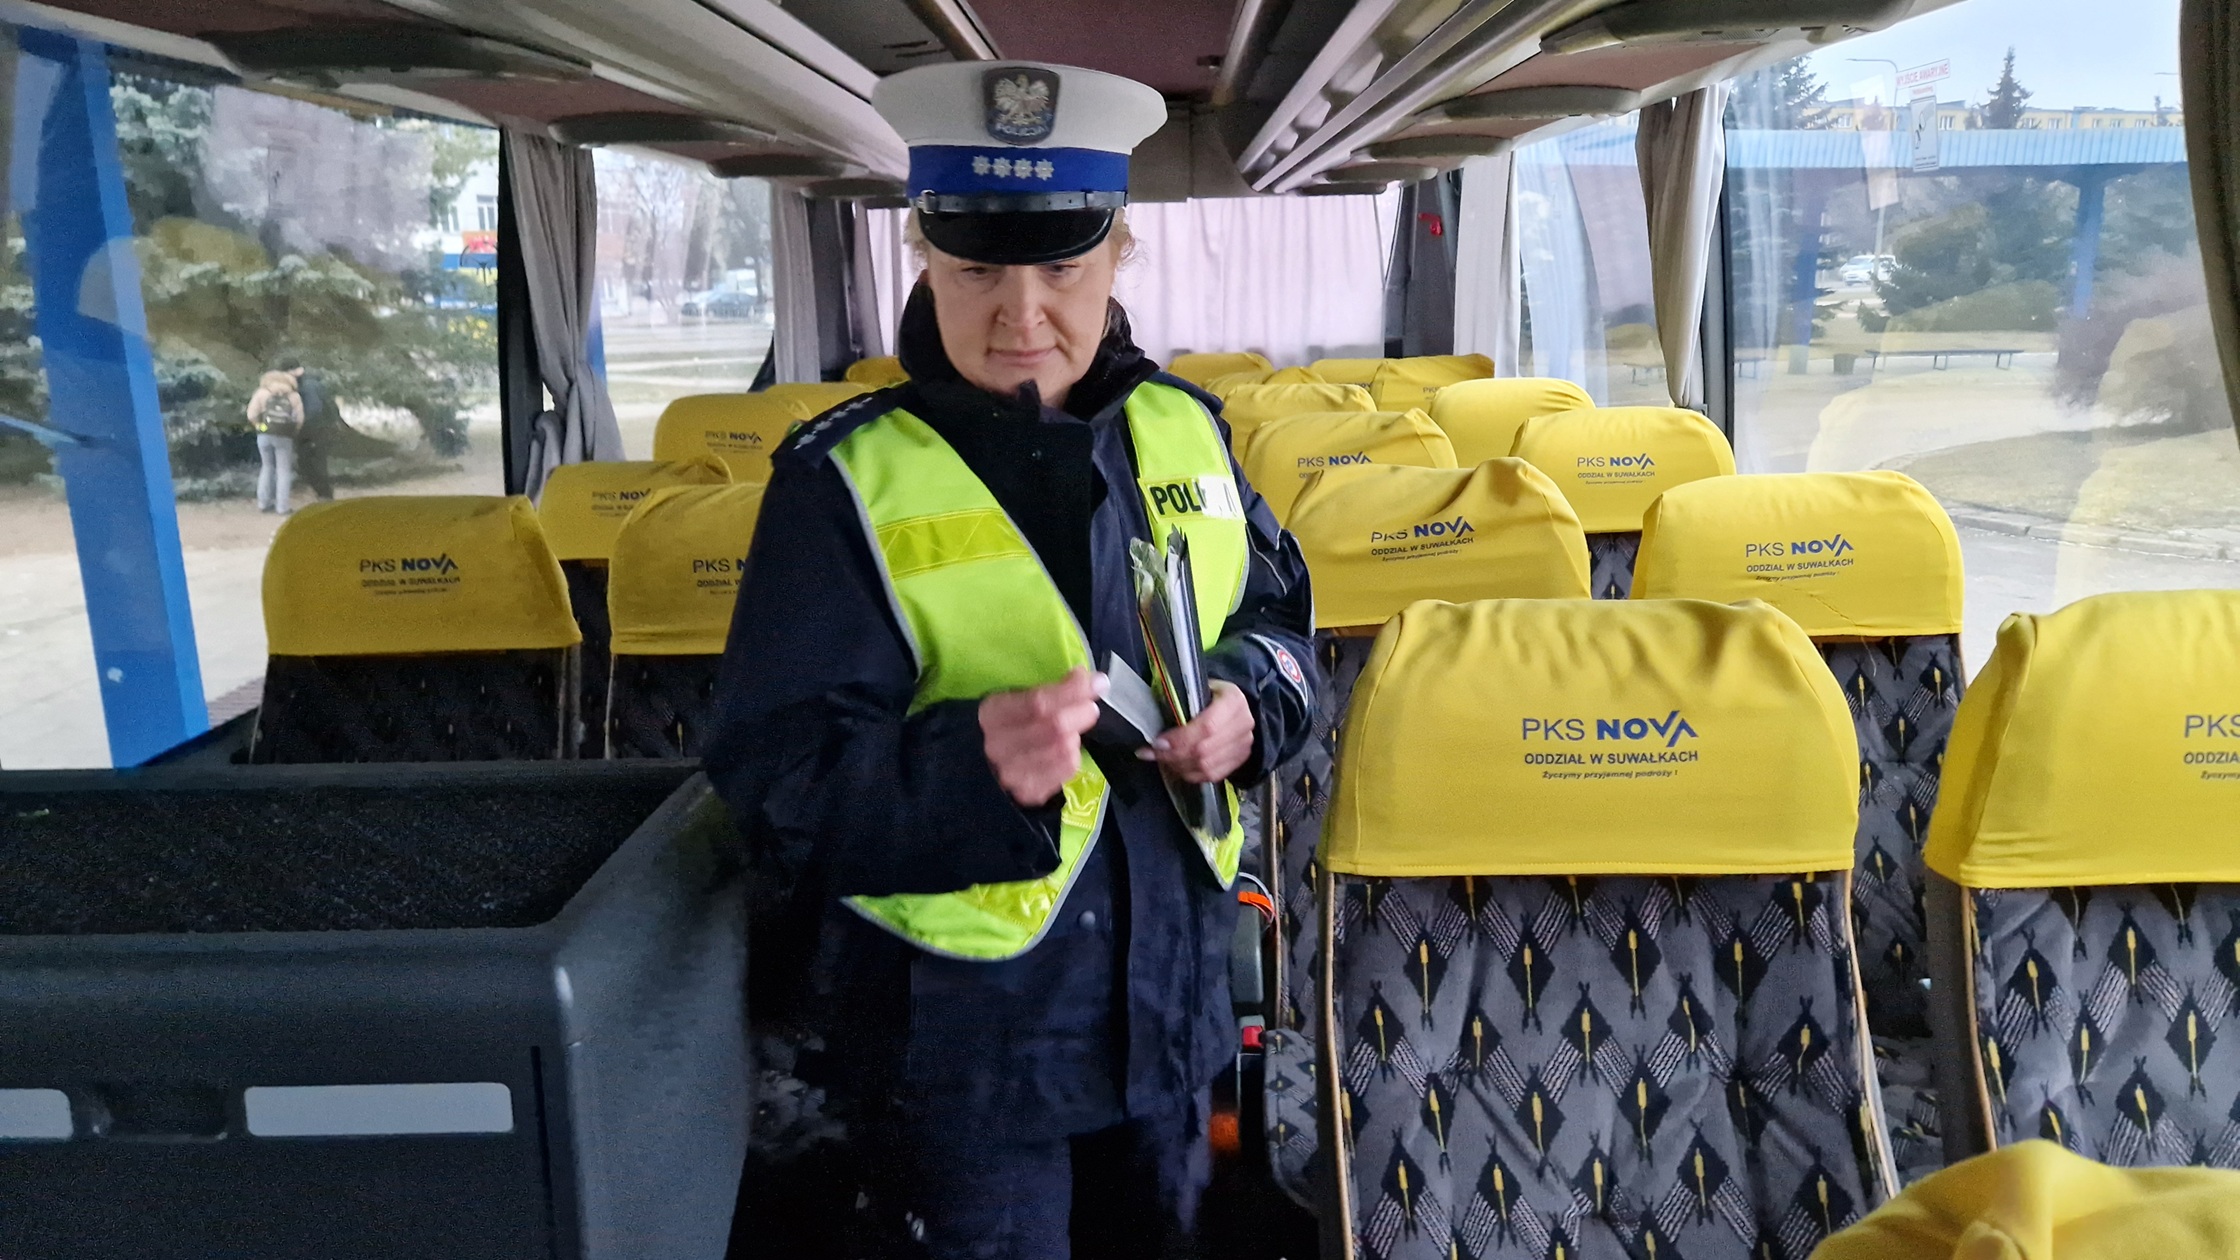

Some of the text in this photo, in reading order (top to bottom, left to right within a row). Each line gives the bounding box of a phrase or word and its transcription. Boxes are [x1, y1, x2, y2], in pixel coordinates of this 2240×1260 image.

[996, 122, 1048, 137] POLICJA
[729, 431, 762, 444] NOVA
[1297, 451, 1373, 468] PKS NOVA
[1577, 453, 1655, 470] PKS NOVA
[620, 488, 651, 500] NOV
[1149, 481, 1237, 516] POLI
[1371, 516, 1475, 543] PKS NOVA
[1420, 537, 1474, 550] SUWAŁKACH
[1745, 533, 1855, 558] PKS NOVA
[360, 553, 459, 575] PKS NOVA
[692, 558, 730, 573] PKS
[1746, 558, 1854, 573] ODDZIAŁ W SUWAŁKACH
[1522, 710, 1699, 748] PKS NOVA
[1524, 750, 1698, 765] ODDZIAŁ W SUWAŁKACH
[2183, 751, 2240, 765] ODDZIA
